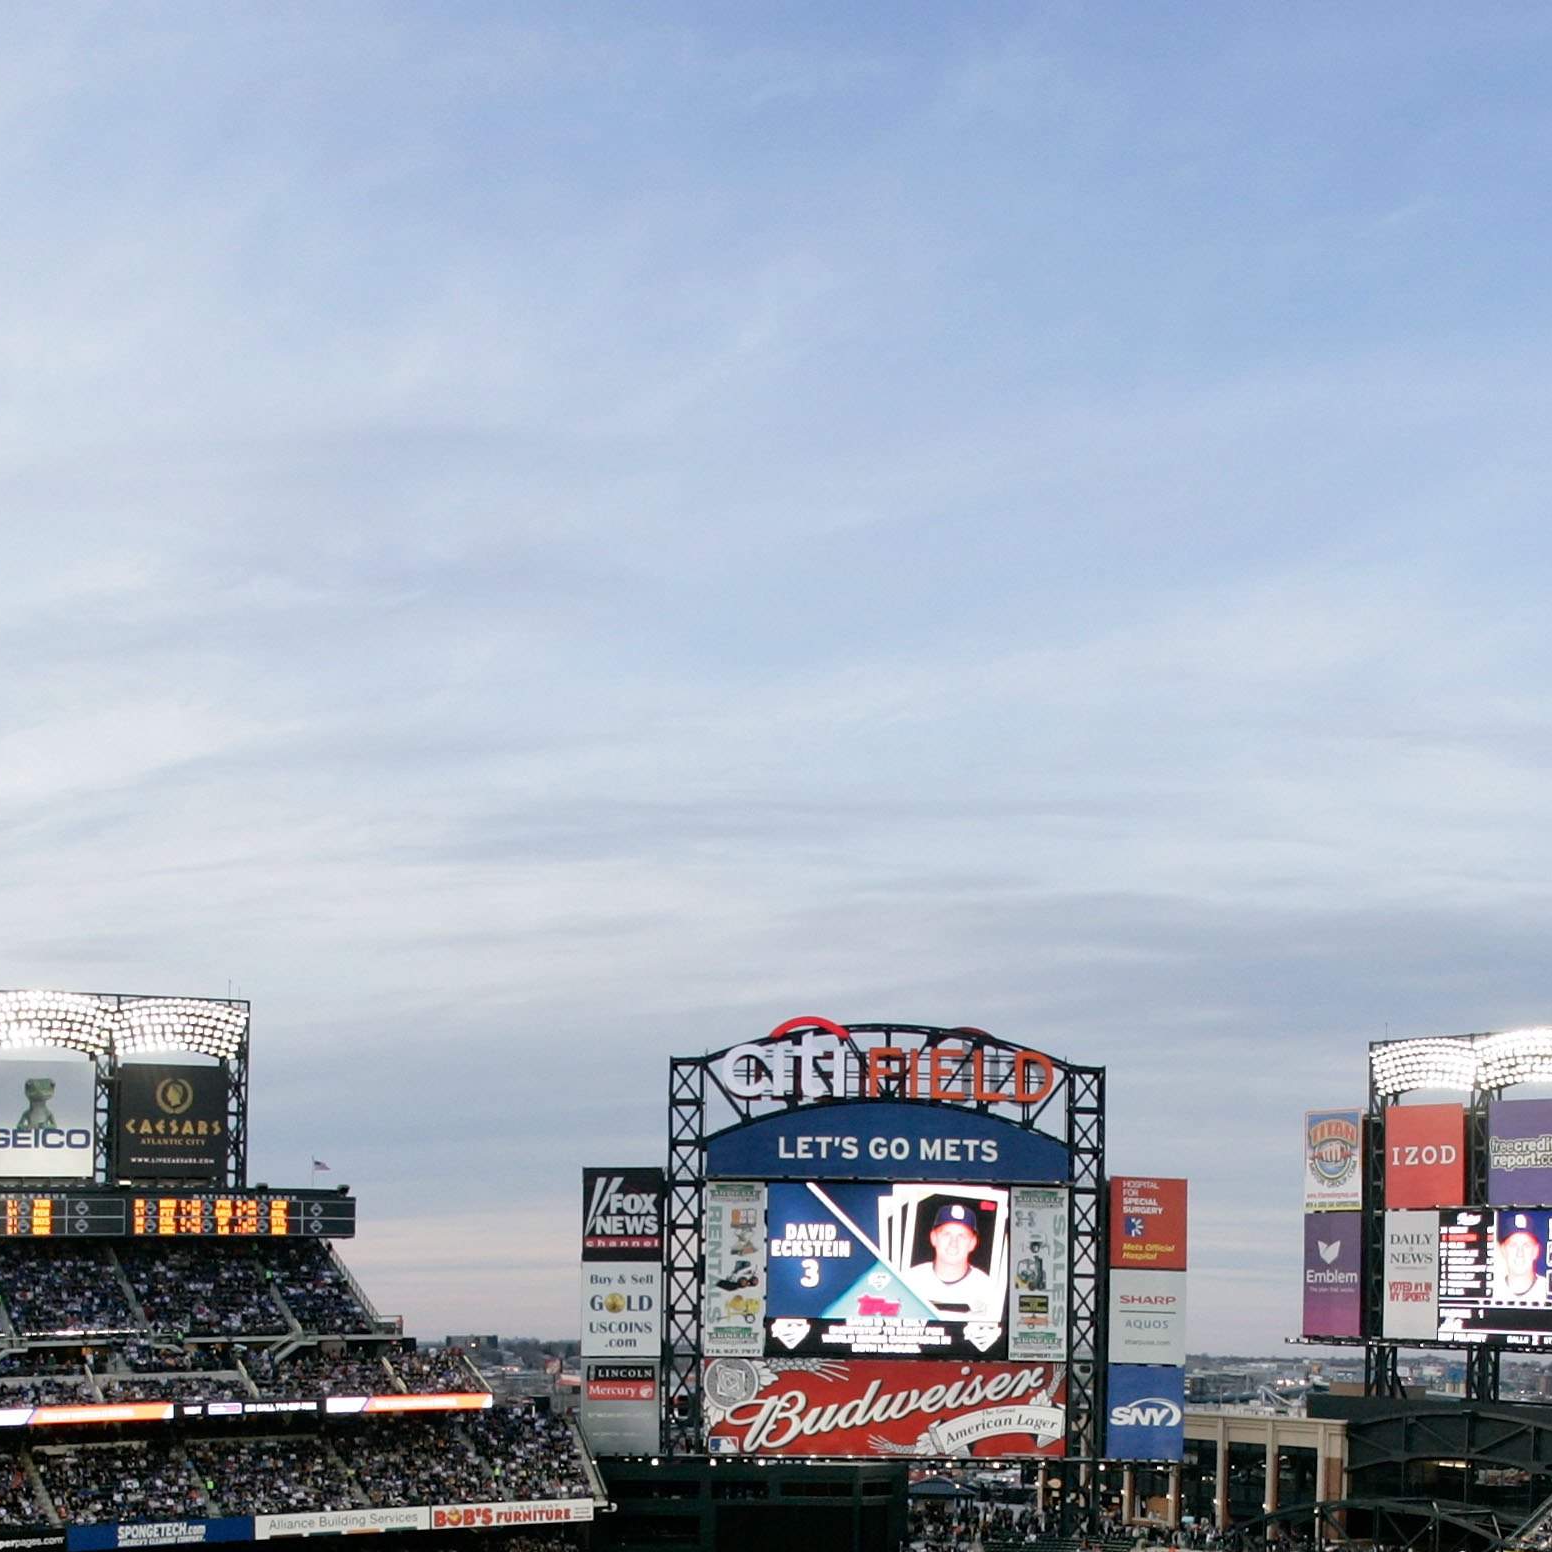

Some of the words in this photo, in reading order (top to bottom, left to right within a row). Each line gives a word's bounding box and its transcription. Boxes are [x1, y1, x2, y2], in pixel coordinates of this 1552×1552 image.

[722, 1030, 847, 1098] citi
[869, 1046, 1054, 1103] FIELD
[125, 1118, 222, 1135] CAESARS
[1310, 1119, 1357, 1145] TITAN
[141, 1137, 184, 1146] ATLANTIC
[186, 1138, 206, 1146] CITY
[778, 1136, 858, 1159] LET'S
[869, 1140, 910, 1160] GO
[920, 1140, 998, 1162] METS
[1392, 1145, 1457, 1165] IZOD
[1123, 1181, 1159, 1189] HOSPITAL
[1123, 1189, 1139, 1197] FOR
[609, 1193, 657, 1215] FOX
[1123, 1198, 1158, 1206] SPECIAL
[1123, 1206, 1163, 1215] SURGERY
[595, 1215, 658, 1235] NEWS
[785, 1223, 836, 1240] DAVID
[586, 1239, 659, 1247] channel
[1390, 1233, 1433, 1245] DAILY
[771, 1240, 851, 1258] ECKSTEIN
[706, 1205, 722, 1323] RENTALS
[1390, 1253, 1433, 1264] NEWS
[800, 1259, 819, 1288] 3
[1052, 1214, 1065, 1328] SALES
[1306, 1269, 1358, 1284] Emblem
[590, 1274, 612, 1285] Buy
[618, 1274, 626, 1284] &
[631, 1274, 653, 1284] Sell
[1120, 1295, 1176, 1304] SHARP
[589, 1321, 652, 1334] USCOINS
[1125, 1320, 1169, 1329] AQUOS
[605, 1337, 637, 1348] .com
[598, 1368, 653, 1378] LINCOLN
[588, 1385, 638, 1398] Mercury
[726, 1366, 1044, 1451] Budweiser
[1111, 1407, 1171, 1427] SNY
[946, 1415, 1014, 1443] American
[1017, 1414, 1058, 1433] Lager
[269, 1517, 315, 1530] Alliance
[318, 1515, 366, 1529] Building
[370, 1512, 418, 1524] Services
[496, 1509, 571, 1523] FURNITURE
[117, 1522, 206, 1539] SPONGETECH.com
